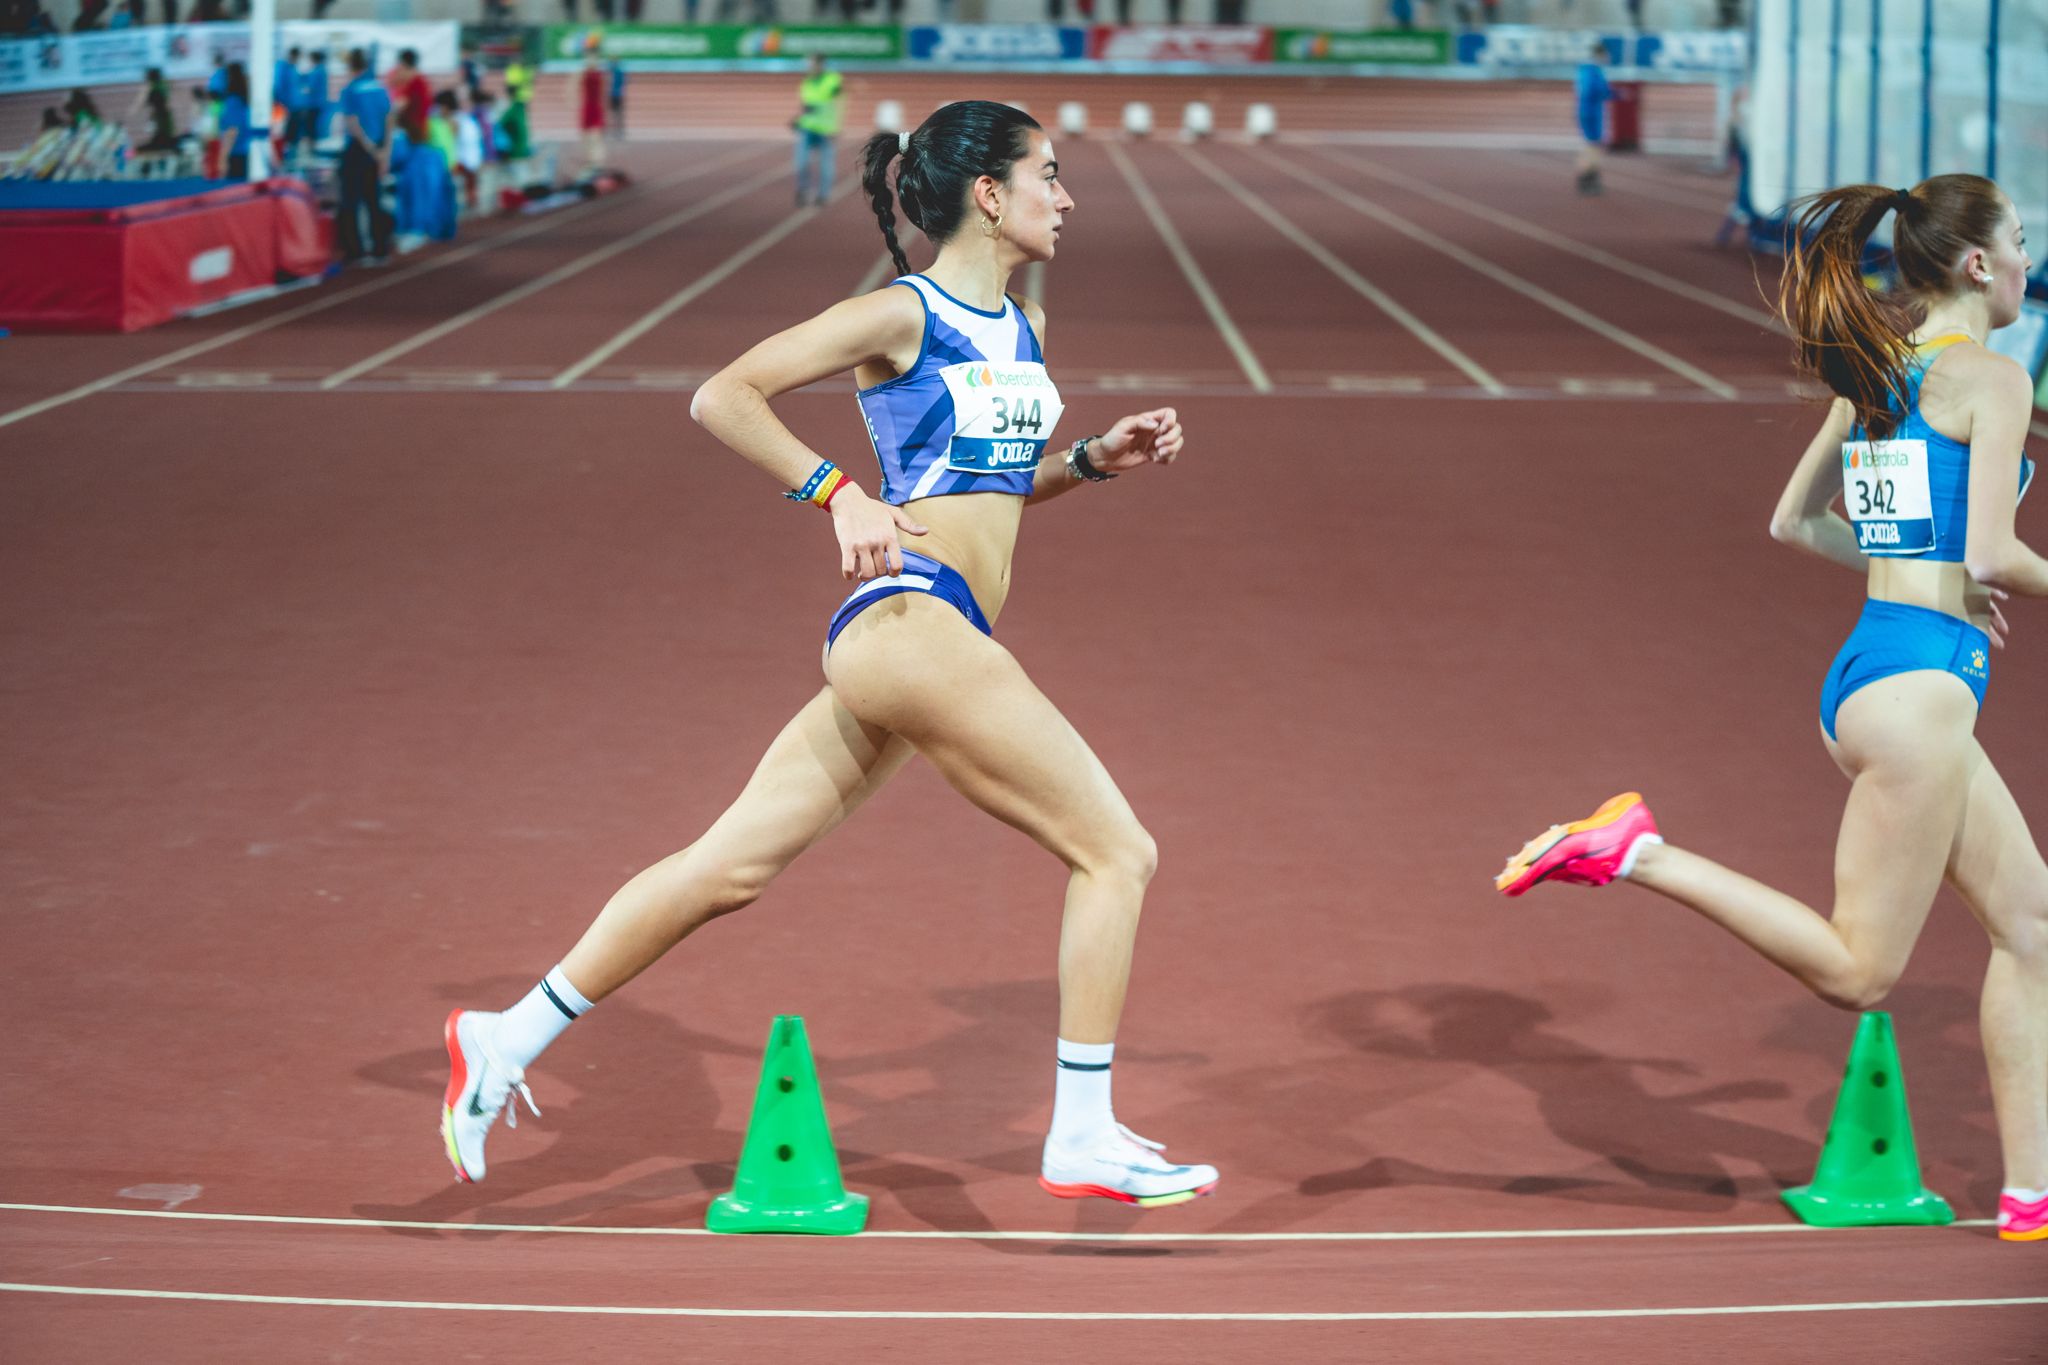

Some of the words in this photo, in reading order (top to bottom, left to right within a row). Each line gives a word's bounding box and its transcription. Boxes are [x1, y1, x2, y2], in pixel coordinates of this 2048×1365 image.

[992, 397, 1042, 434] 344
[1862, 450, 1908, 468] Iberdrola
[1856, 479, 1896, 515] 342
